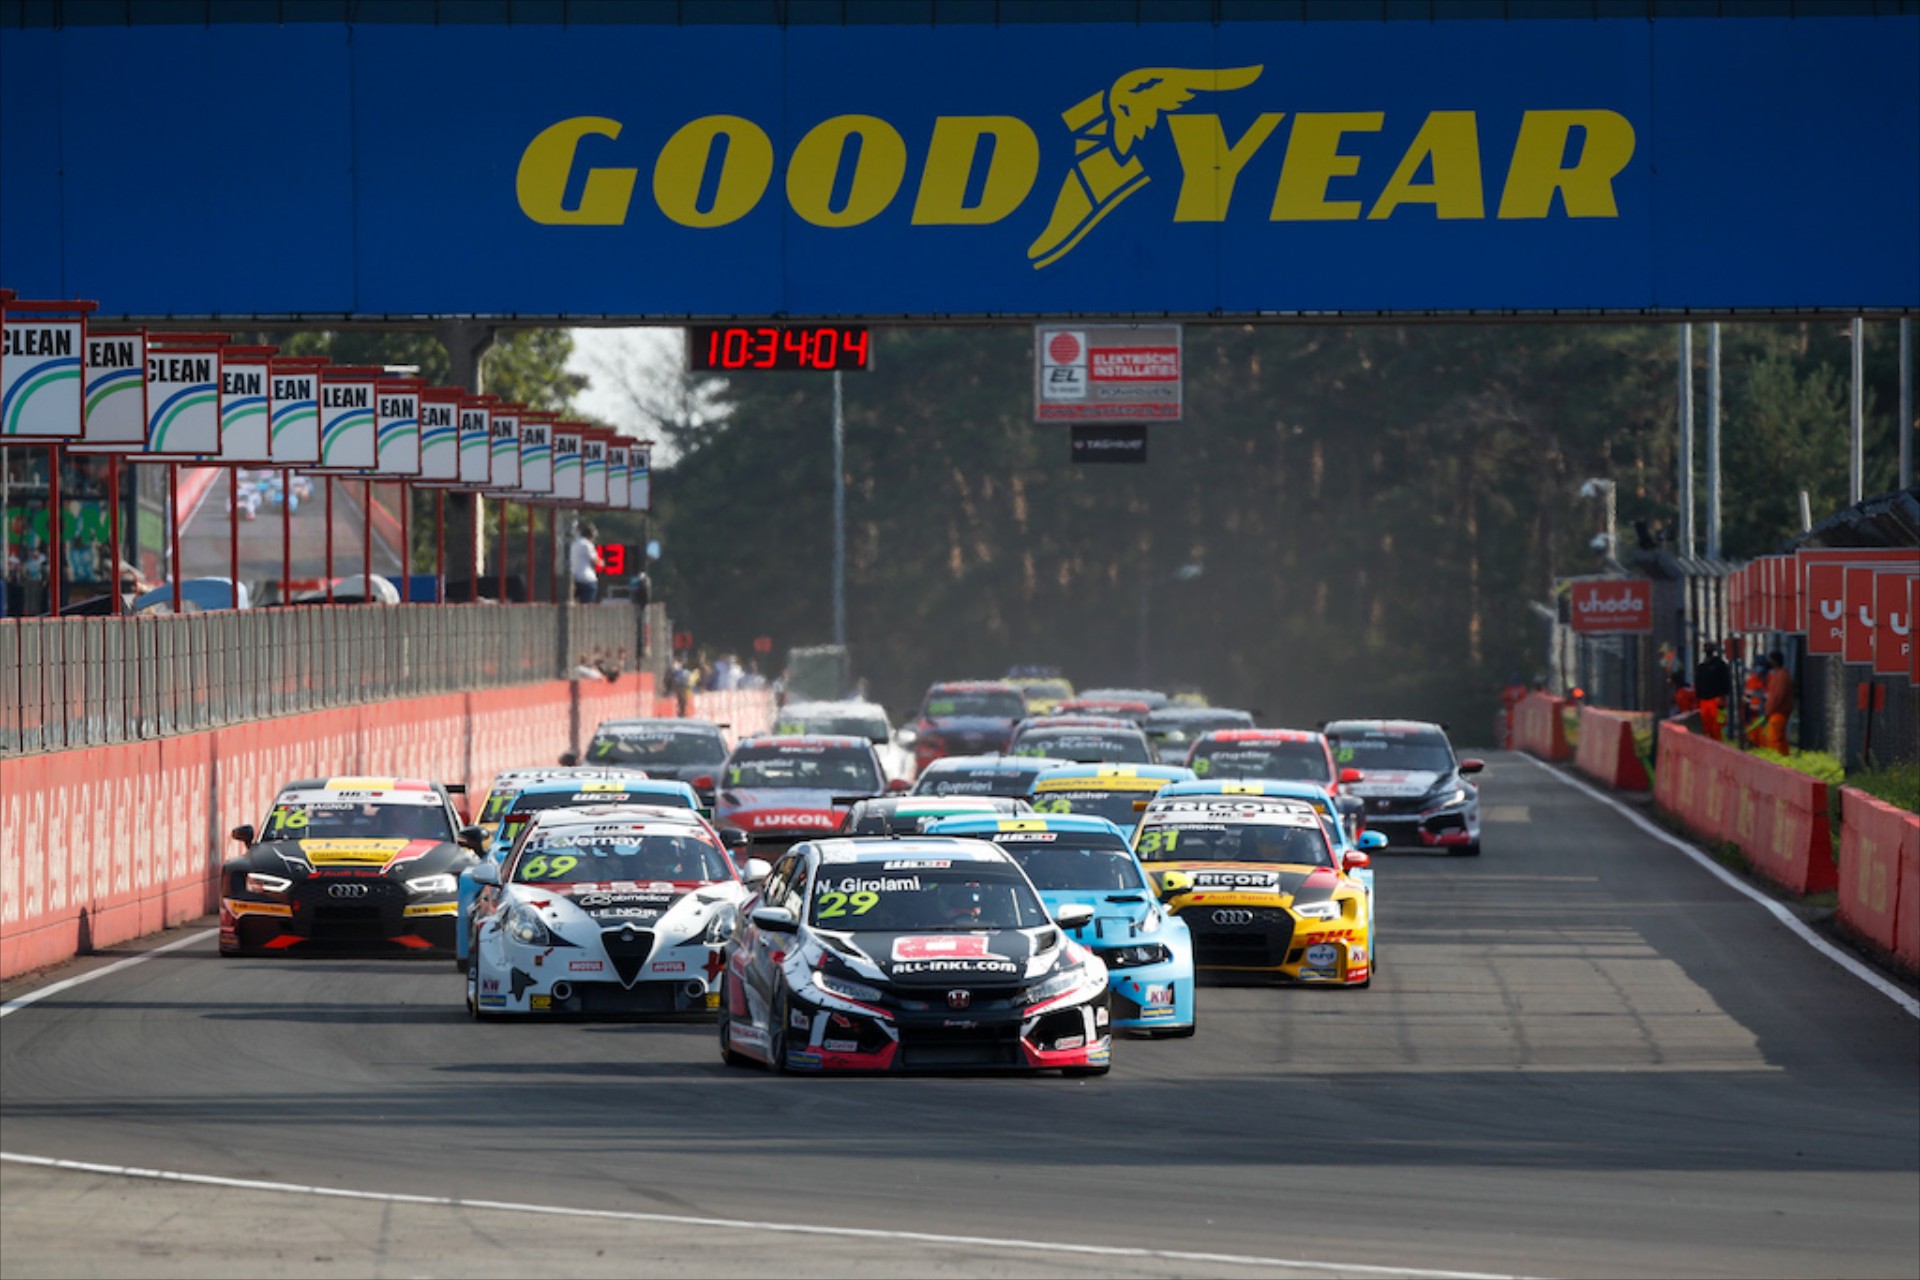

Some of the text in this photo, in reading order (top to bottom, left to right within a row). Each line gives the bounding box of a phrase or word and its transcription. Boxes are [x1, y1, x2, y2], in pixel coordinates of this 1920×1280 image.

[86, 342, 134, 367] EAN
[708, 328, 868, 369] 10:34:04
[1050, 369, 1079, 383] EL
[273, 380, 310, 400] EAN
[379, 399, 413, 418] EAN
[272, 810, 309, 831] 16
[754, 815, 834, 828] LUKOIL
[1138, 830, 1180, 852] 31
[521, 856, 578, 878] 69
[816, 876, 920, 893] N. Girolami
[817, 891, 880, 919] 29
